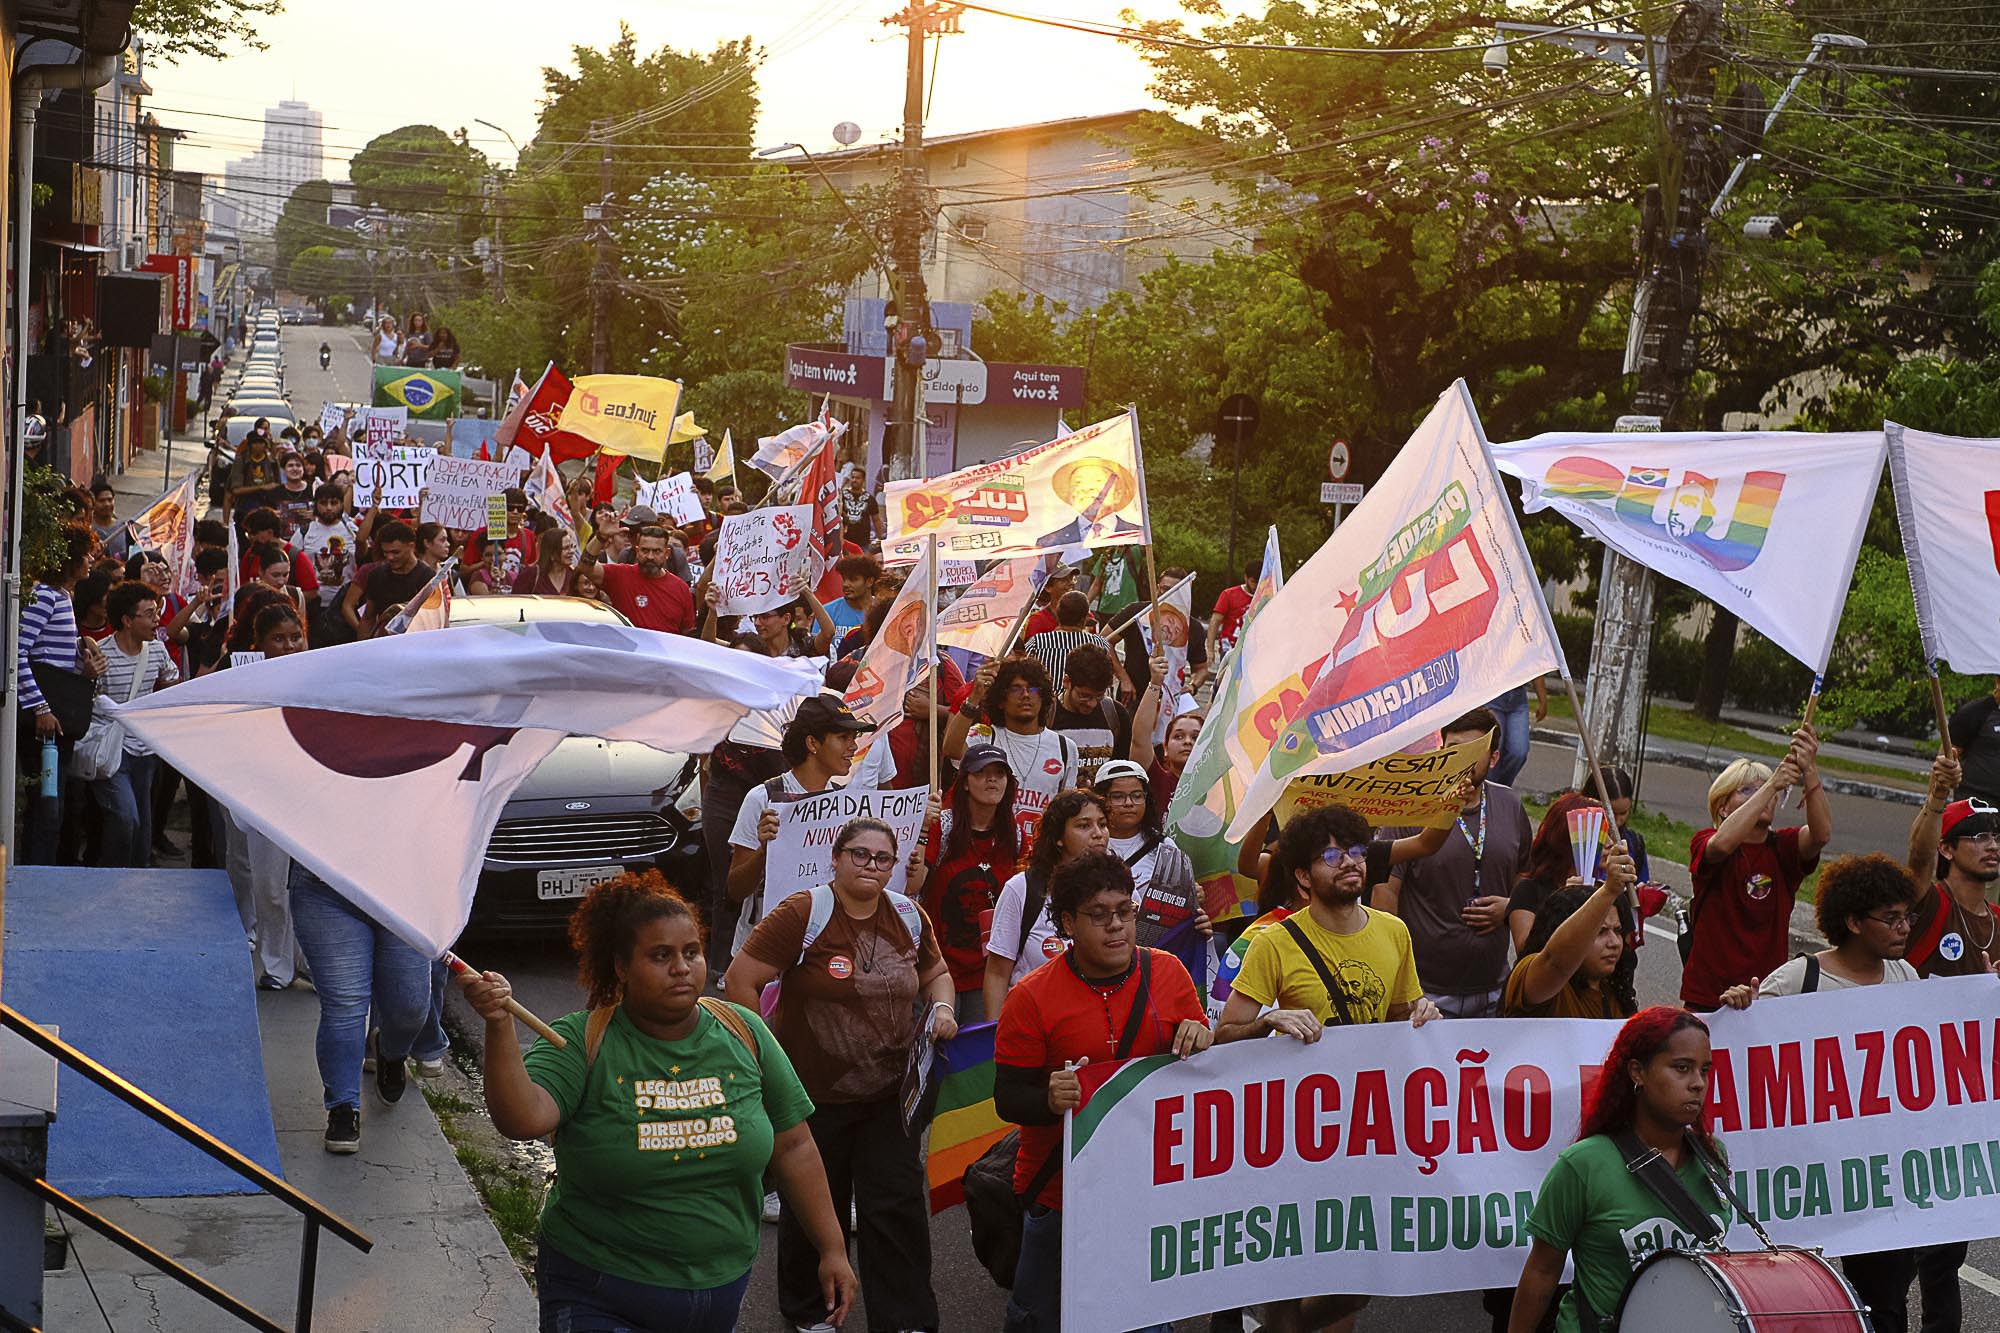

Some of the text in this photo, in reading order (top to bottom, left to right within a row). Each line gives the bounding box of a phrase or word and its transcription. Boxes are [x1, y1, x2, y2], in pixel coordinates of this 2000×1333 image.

[177, 259, 187, 325] DROGARIA
[789, 359, 846, 383] Aqui tem vivo
[1013, 370, 1060, 382] Aqui tem
[932, 382, 979, 393] Eldodo
[1013, 385, 1046, 399] vivo
[439, 459, 519, 480] DEMOCRACIA
[461, 475, 479, 489] EM
[746, 572, 772, 598] 13
[789, 791, 926, 824] MAPA DA FOME
[798, 862, 817, 878] DIA
[1146, 887, 1186, 908] O QUE DEVE SER
[635, 1077, 721, 1096] LEGALIZAR
[635, 1091, 726, 1110] O ABORTO
[638, 1115, 734, 1137] DIREITO AO
[1153, 1047, 1552, 1185] EDUCAÇÃO
[639, 1129, 738, 1150] NOSSO CORPO
[1151, 1202, 1302, 1283] DEFESA
[1315, 1195, 1378, 1254] DA
[1391, 1190, 1534, 1253] EDUCA
[1841, 1153, 1893, 1213] DE
